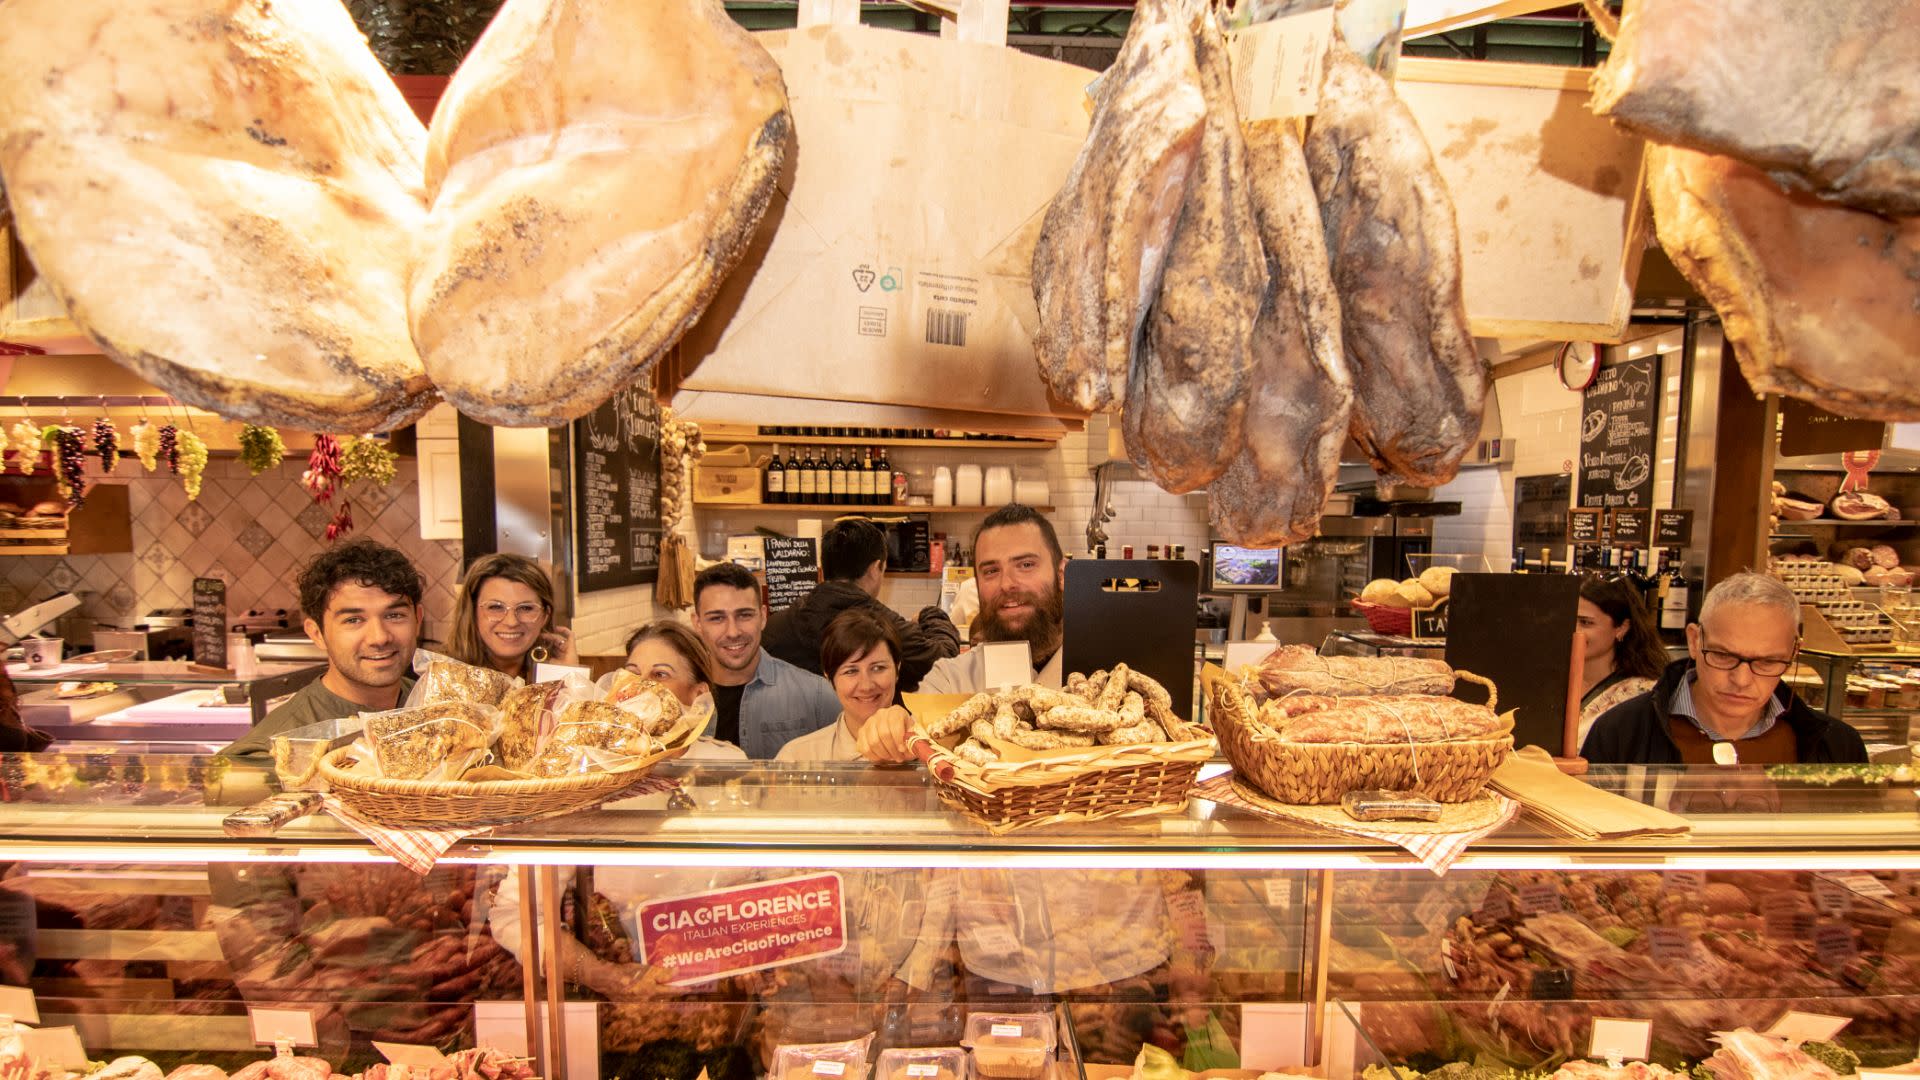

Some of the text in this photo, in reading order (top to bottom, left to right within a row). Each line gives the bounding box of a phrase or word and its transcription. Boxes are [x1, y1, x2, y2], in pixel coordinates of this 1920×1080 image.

[933, 294, 978, 306] Sacchetto carta
[793, 540, 809, 548] DELLA
[1424, 617, 1448, 632] TA
[683, 913, 807, 941] ITALIAN EXPERIENCES
[662, 925, 833, 968] #WeAreCiaoFlorence
